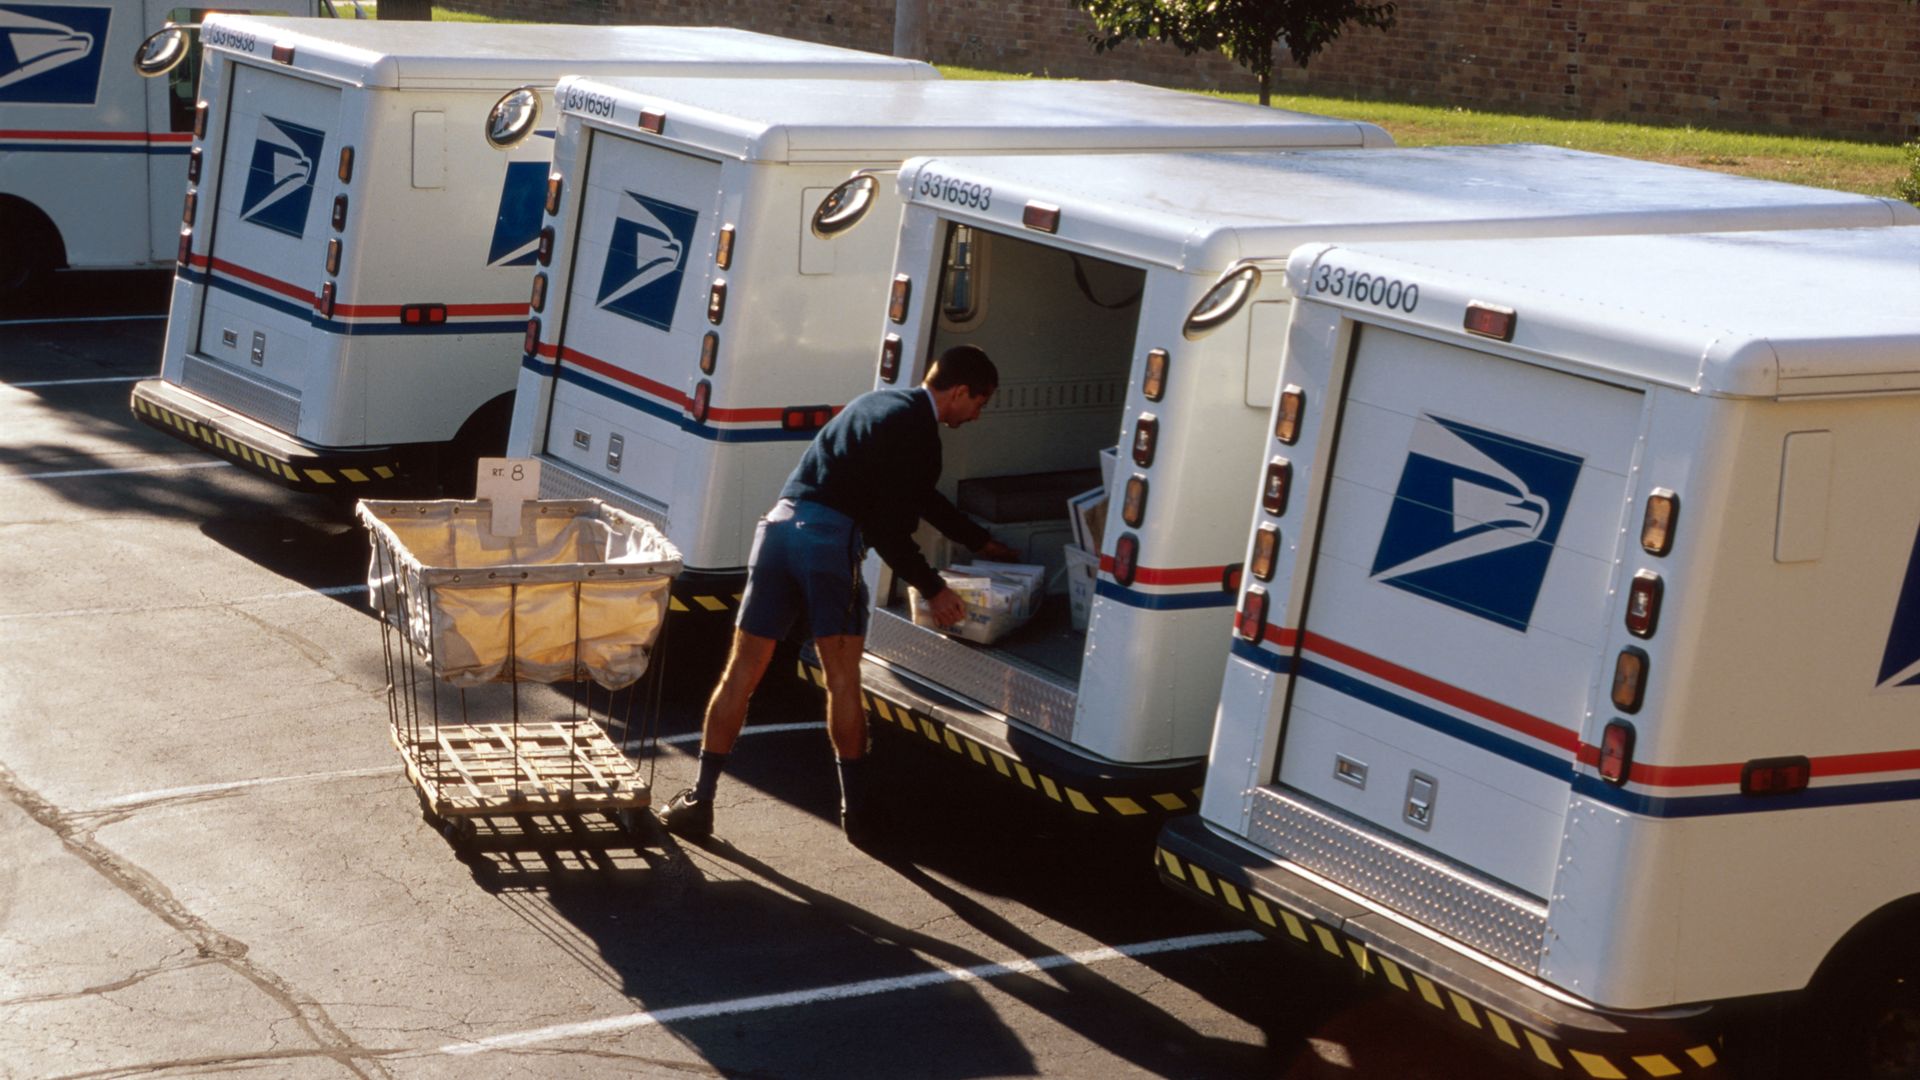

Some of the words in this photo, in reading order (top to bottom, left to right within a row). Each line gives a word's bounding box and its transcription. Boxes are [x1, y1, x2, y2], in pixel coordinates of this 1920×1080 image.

[213, 26, 256, 52] 3315938
[569, 88, 617, 118] 3316591
[920, 172, 992, 211] 3316593
[1315, 264, 1419, 313] 3316000
[511, 464, 524, 481] 8
